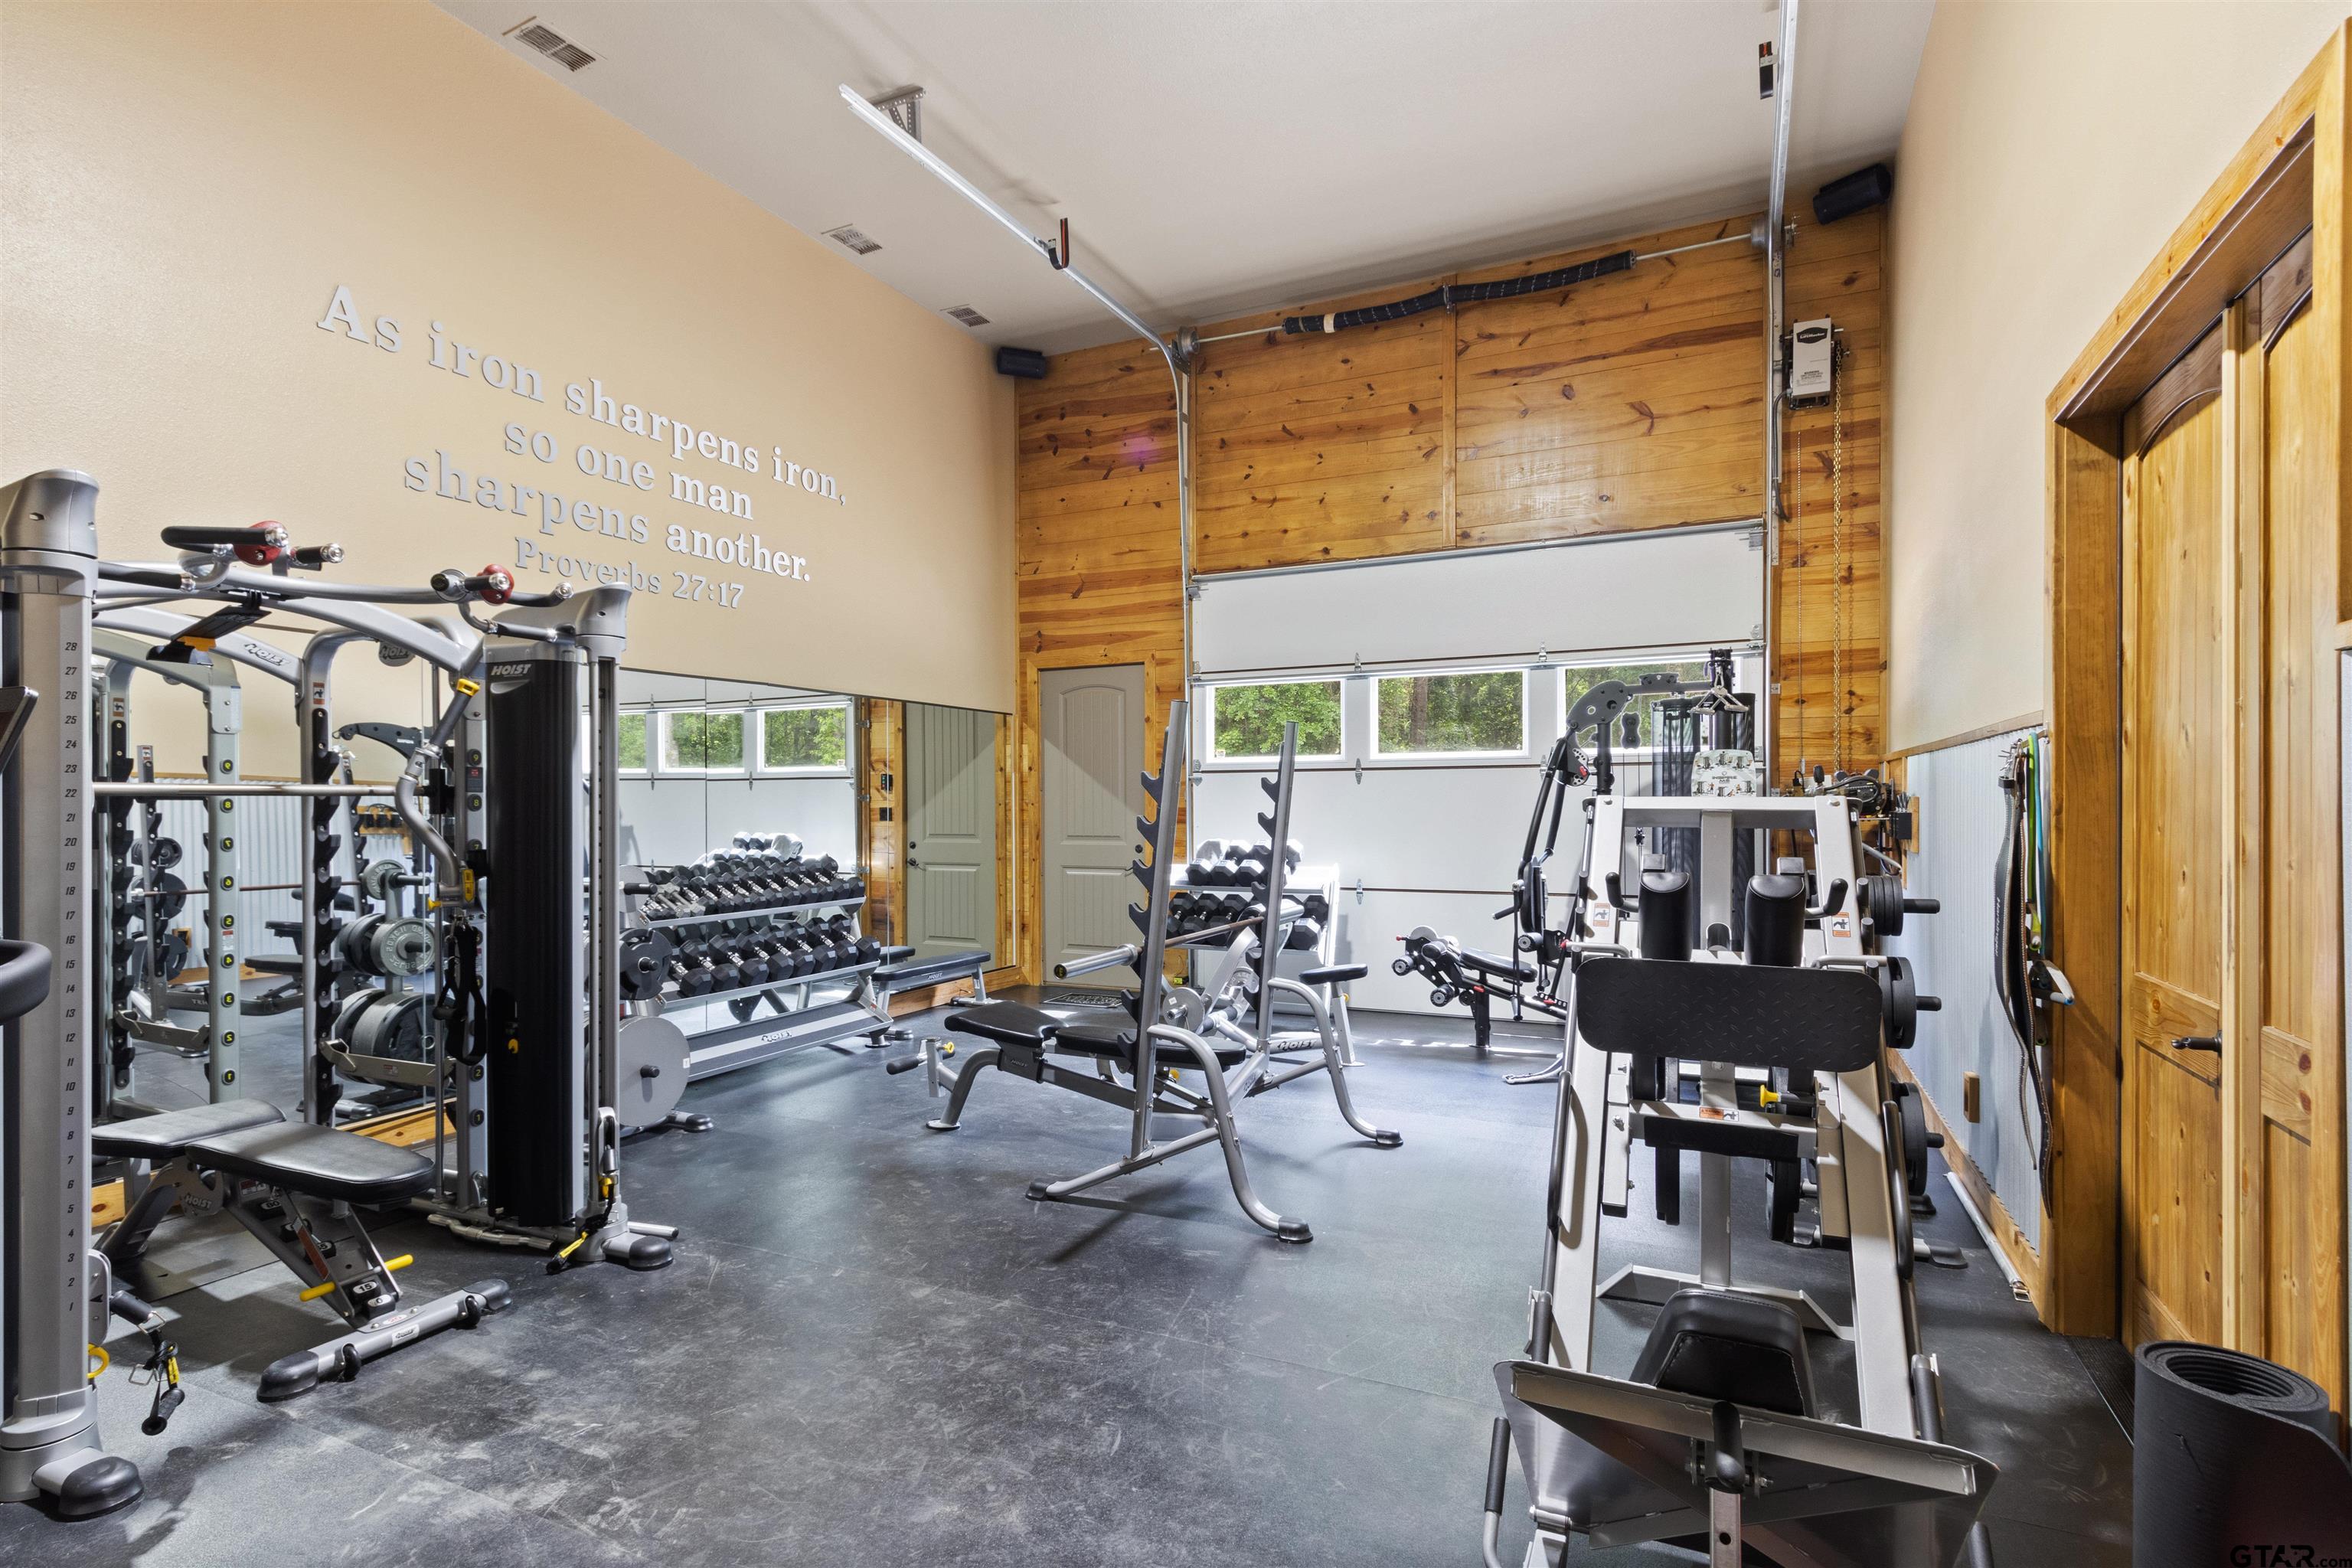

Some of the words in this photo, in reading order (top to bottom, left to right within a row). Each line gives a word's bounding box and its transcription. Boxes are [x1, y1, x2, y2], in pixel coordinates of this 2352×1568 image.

[317, 284, 403, 352] As
[429, 320, 544, 403] iron
[565, 377, 760, 473] sharpens
[773, 446, 848, 505] iron,
[505, 421, 558, 464] so
[577, 443, 656, 491] one
[670, 471, 754, 521] man
[403, 448, 650, 544] sharpens
[666, 522, 811, 582] another.
[514, 536, 662, 594] Proverbs
[672, 570, 745, 610] 27:17
[64, 642, 78, 652] 28
[64, 666, 77, 675] 27
[491, 664, 532, 675] HOIST
[64, 691, 78, 700] 26
[64, 715, 77, 724] 25
[65, 740, 77, 749] 24
[64, 764, 77, 773] 23
[64, 789, 77, 798] 22
[66, 813, 77, 822] 21
[64, 837, 77, 847] 20
[66, 861, 76, 871] 19
[65, 886, 76, 896] 18
[66, 910, 76, 920] 17
[66, 935, 76, 945] 16
[65, 959, 76, 969] 15
[66, 984, 75, 994] 14
[65, 1008, 76, 1018] 13
[66, 1033, 76, 1043] 12
[1278, 1040, 1317, 1051] HOIST
[67, 1057, 74, 1067] 11
[65, 1081, 77, 1092] 10
[67, 1106, 74, 1116] 9
[67, 1130, 74, 1140] 8
[67, 1155, 74, 1165] 7
[67, 1179, 74, 1189] 6
[185, 1194, 213, 1209] HOIST
[67, 1204, 74, 1214] 5
[67, 1228, 74, 1238] 4
[67, 1253, 75, 1263] 3
[67, 1277, 75, 1287] 2
[359, 1283, 372, 1292] 15
[69, 1302, 74, 1312] 1
